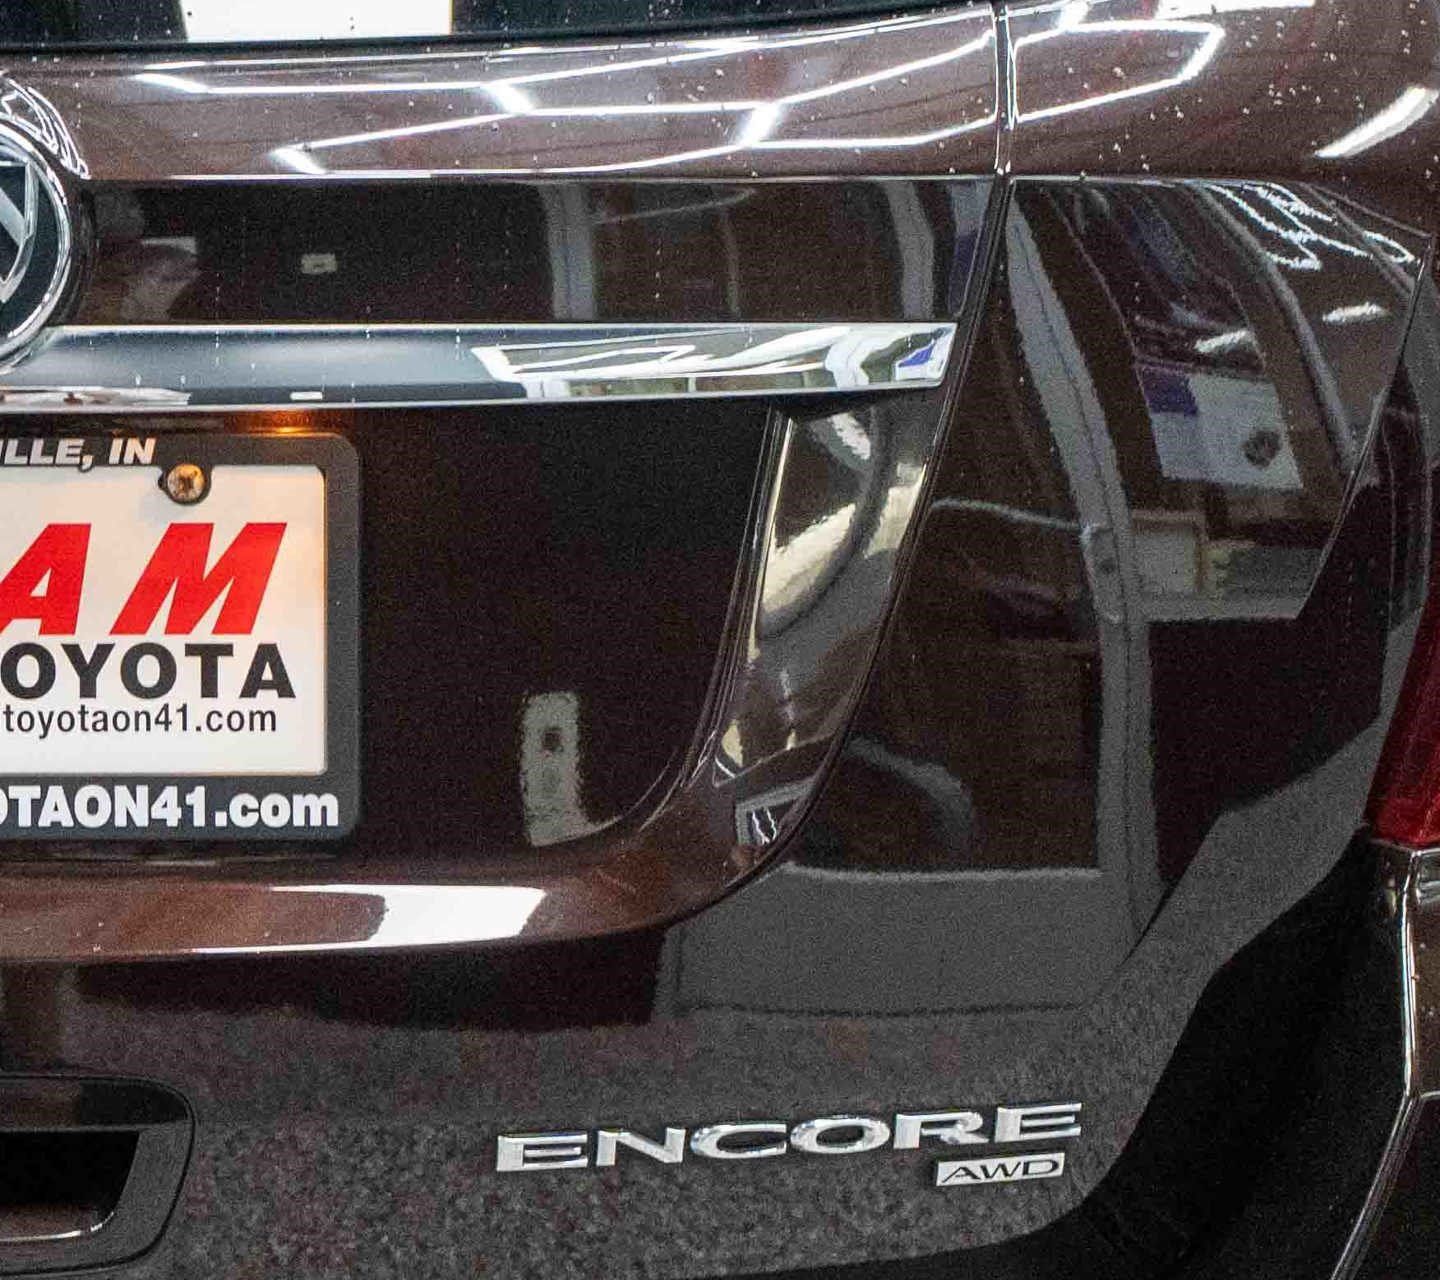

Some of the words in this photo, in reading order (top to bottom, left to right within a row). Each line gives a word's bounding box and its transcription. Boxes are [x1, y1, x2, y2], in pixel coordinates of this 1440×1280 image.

[109, 438, 157, 465] IN
[496, 1102, 1082, 1172] ENCORE
[940, 1157, 1060, 1183] AWD
